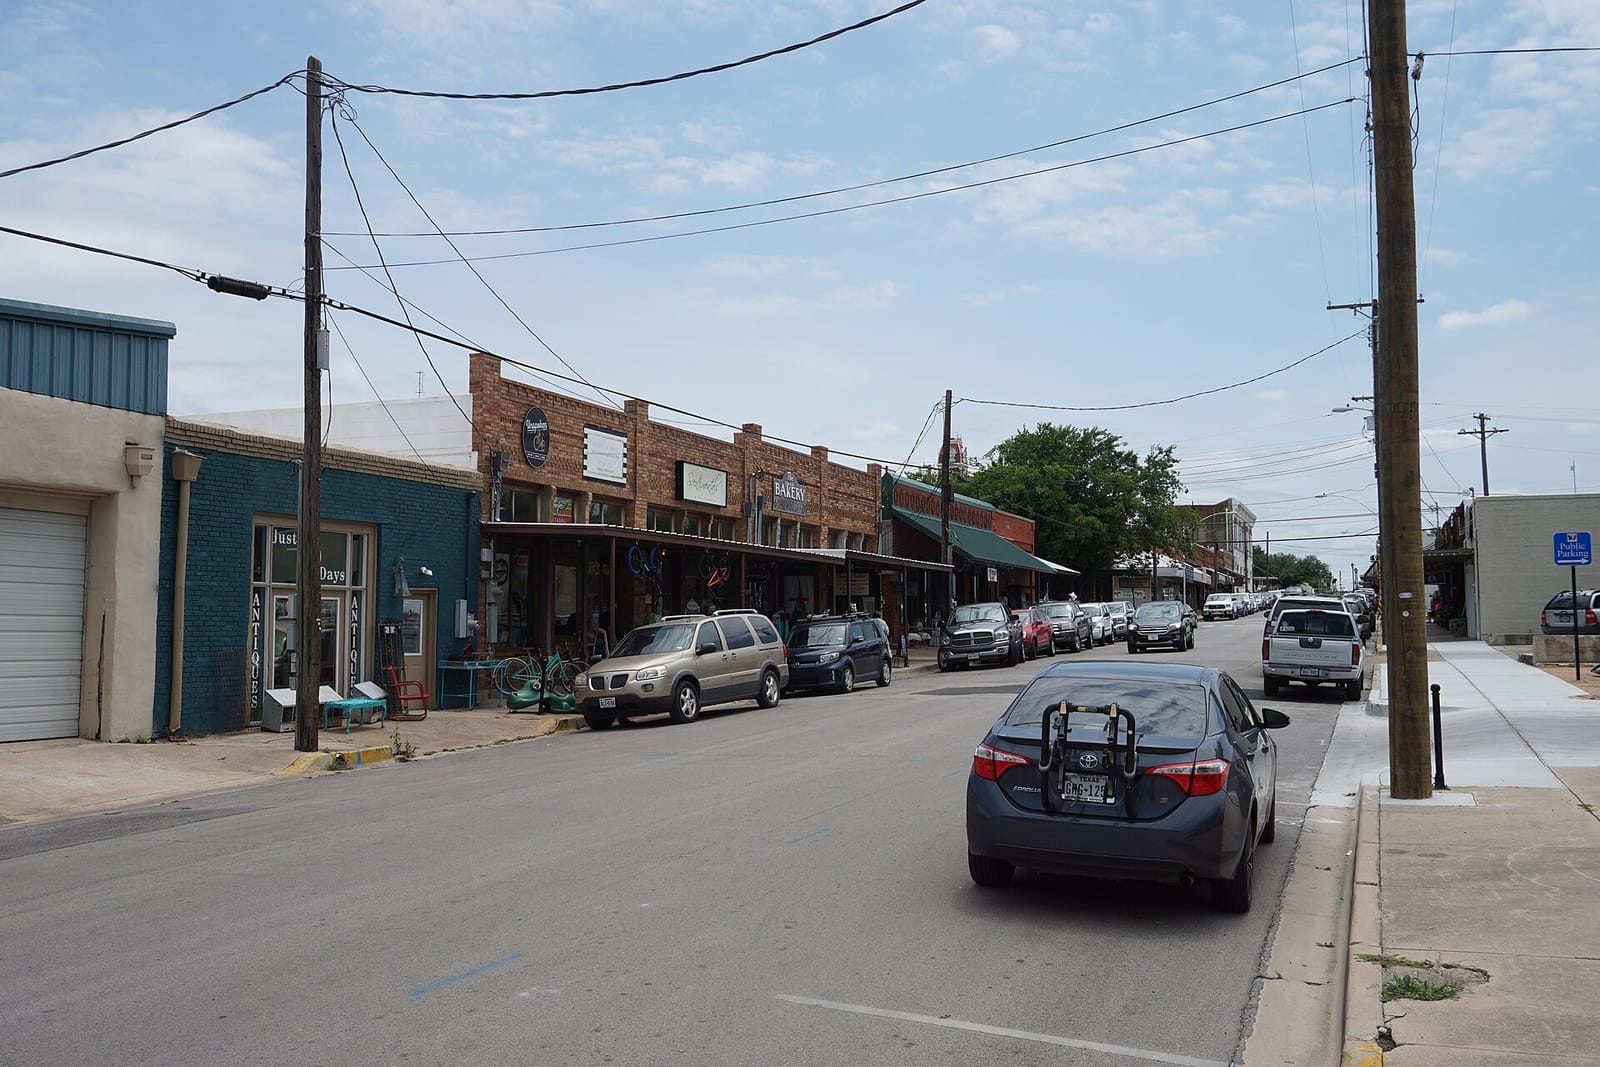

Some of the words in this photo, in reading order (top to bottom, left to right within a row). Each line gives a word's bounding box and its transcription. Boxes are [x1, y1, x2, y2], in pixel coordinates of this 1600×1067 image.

[775, 482, 806, 502] BAKERY
[271, 529, 297, 545] Just
[1557, 550, 1589, 558] Parking
[1560, 542, 1586, 550] Public
[320, 566, 345, 583] Days
[251, 593, 260, 708] ANTIQUES
[350, 596, 358, 696] ANTIQUE
